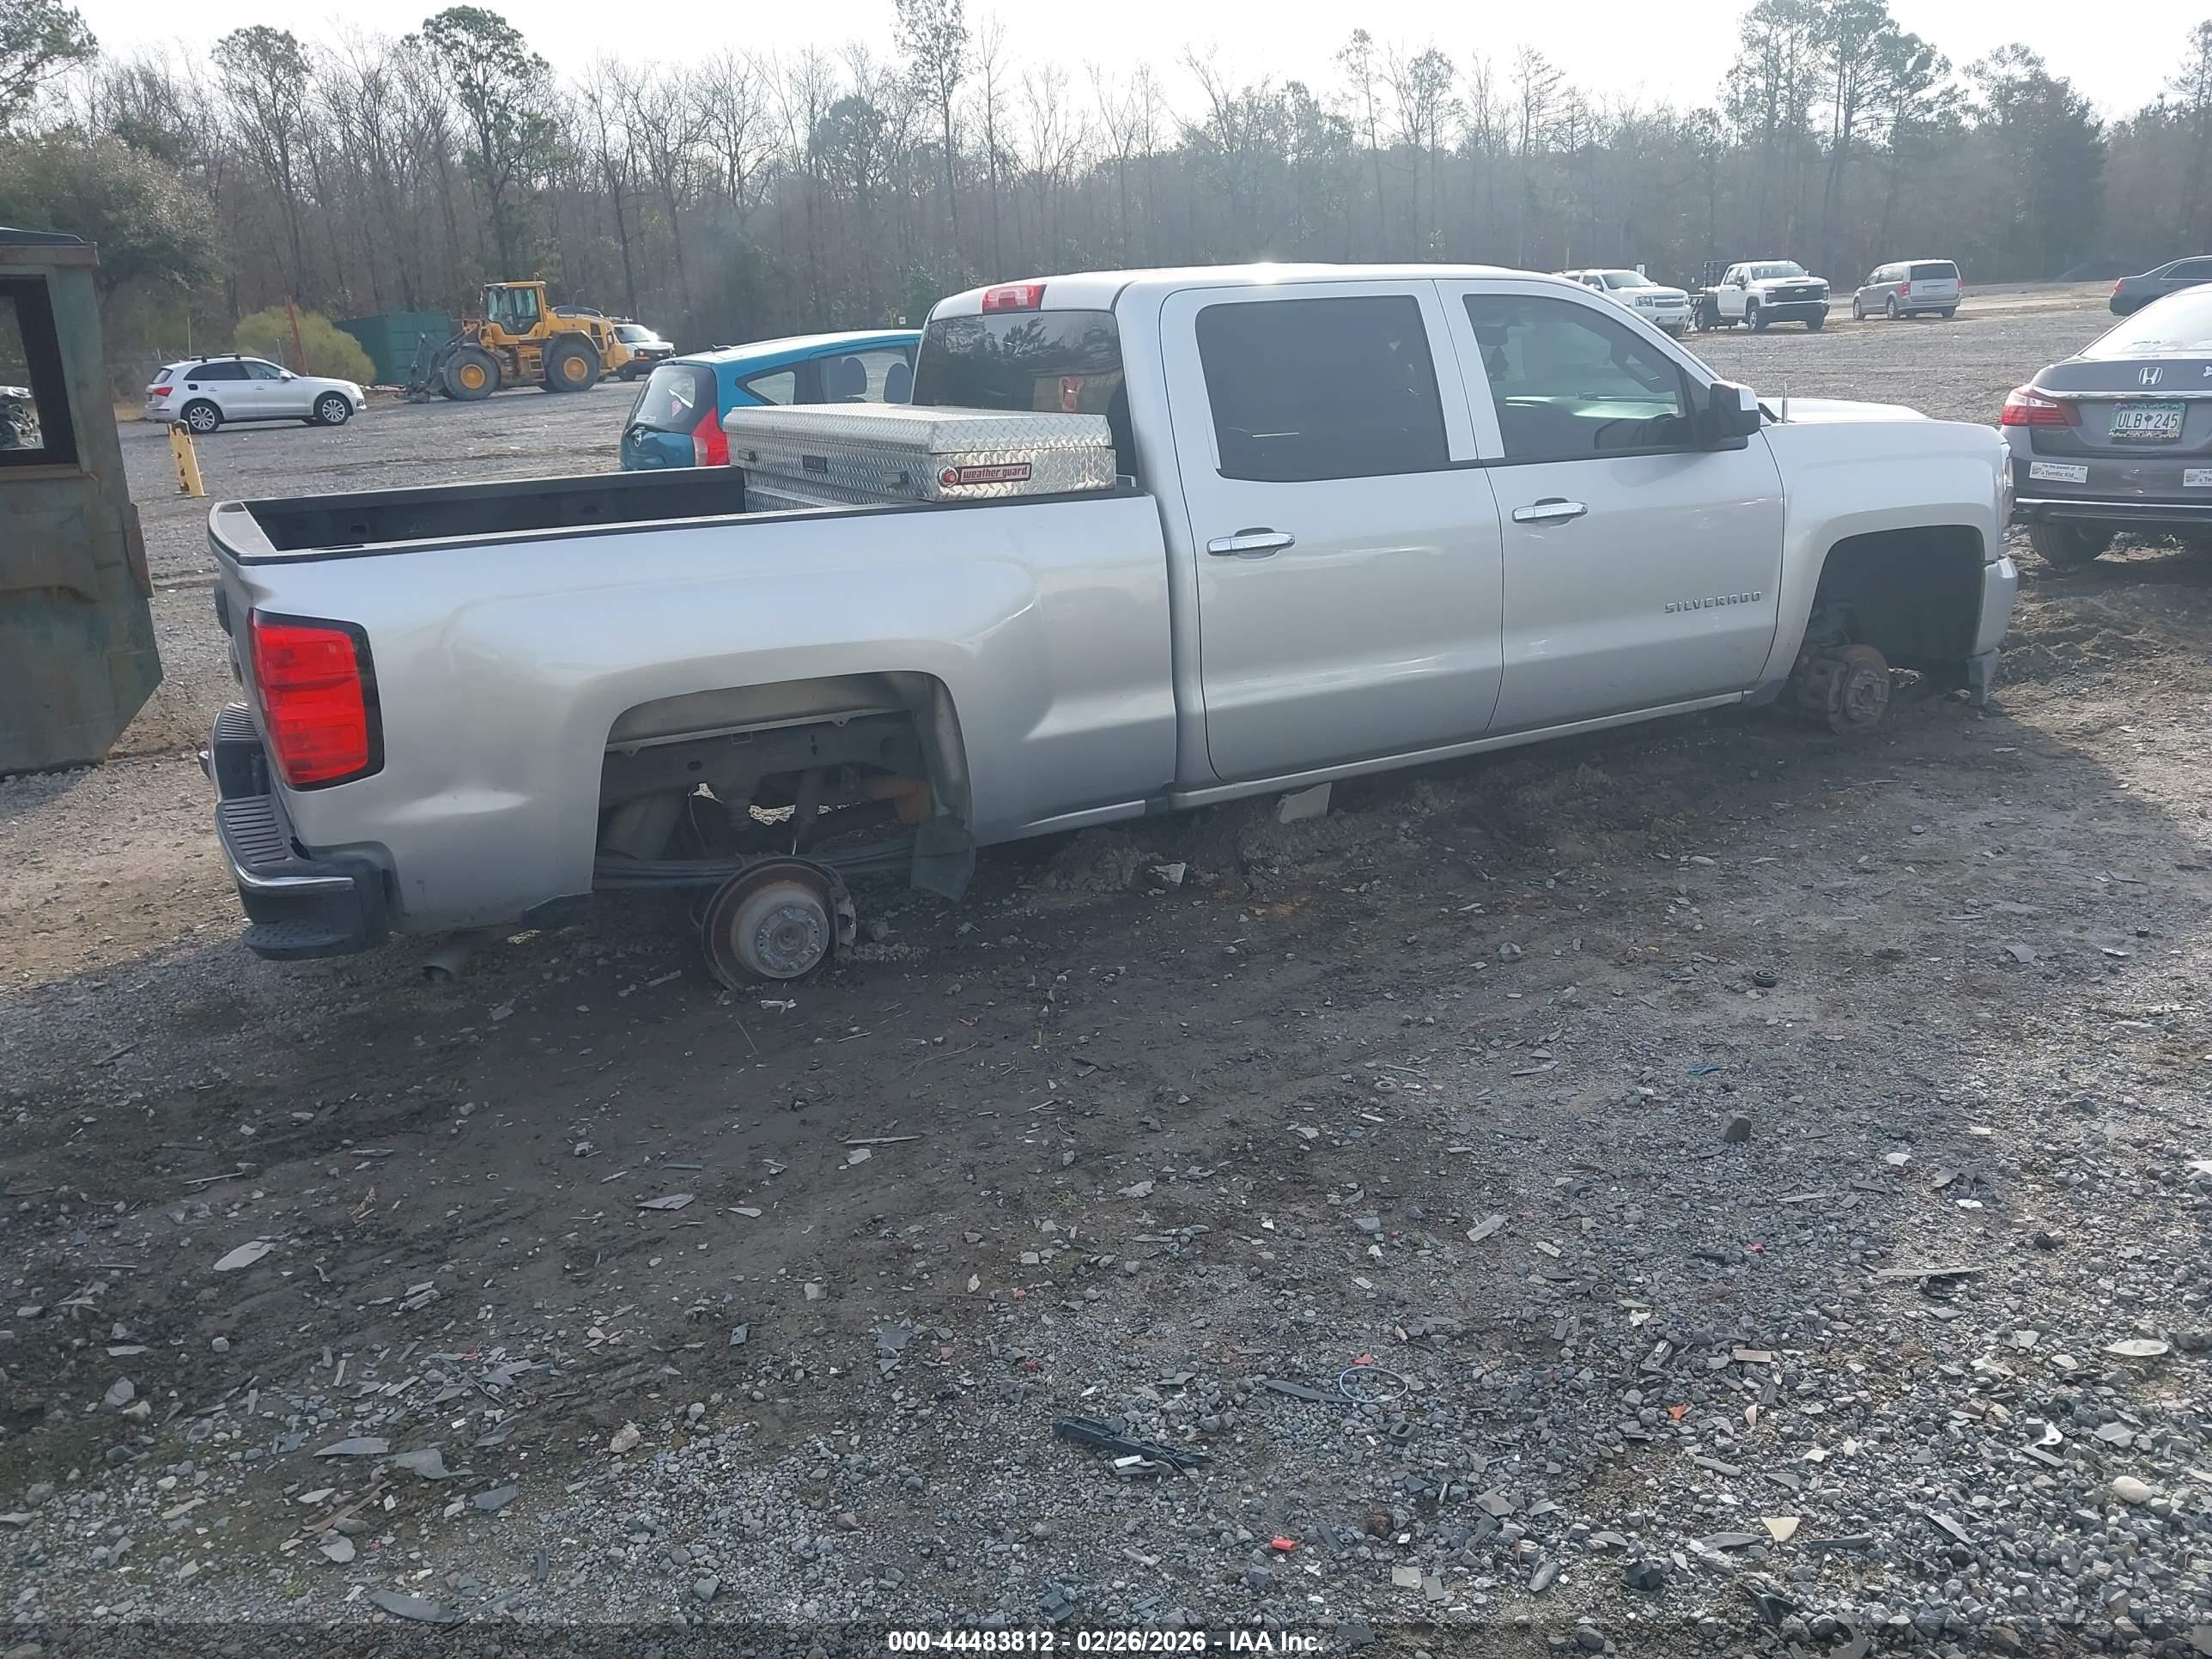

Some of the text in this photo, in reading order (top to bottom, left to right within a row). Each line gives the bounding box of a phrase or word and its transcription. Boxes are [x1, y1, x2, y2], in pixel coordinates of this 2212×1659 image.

[2118, 413, 2179, 428] ULB 245
[963, 465, 1028, 479] weather guard
[1664, 591, 1762, 614] SILVERADO
